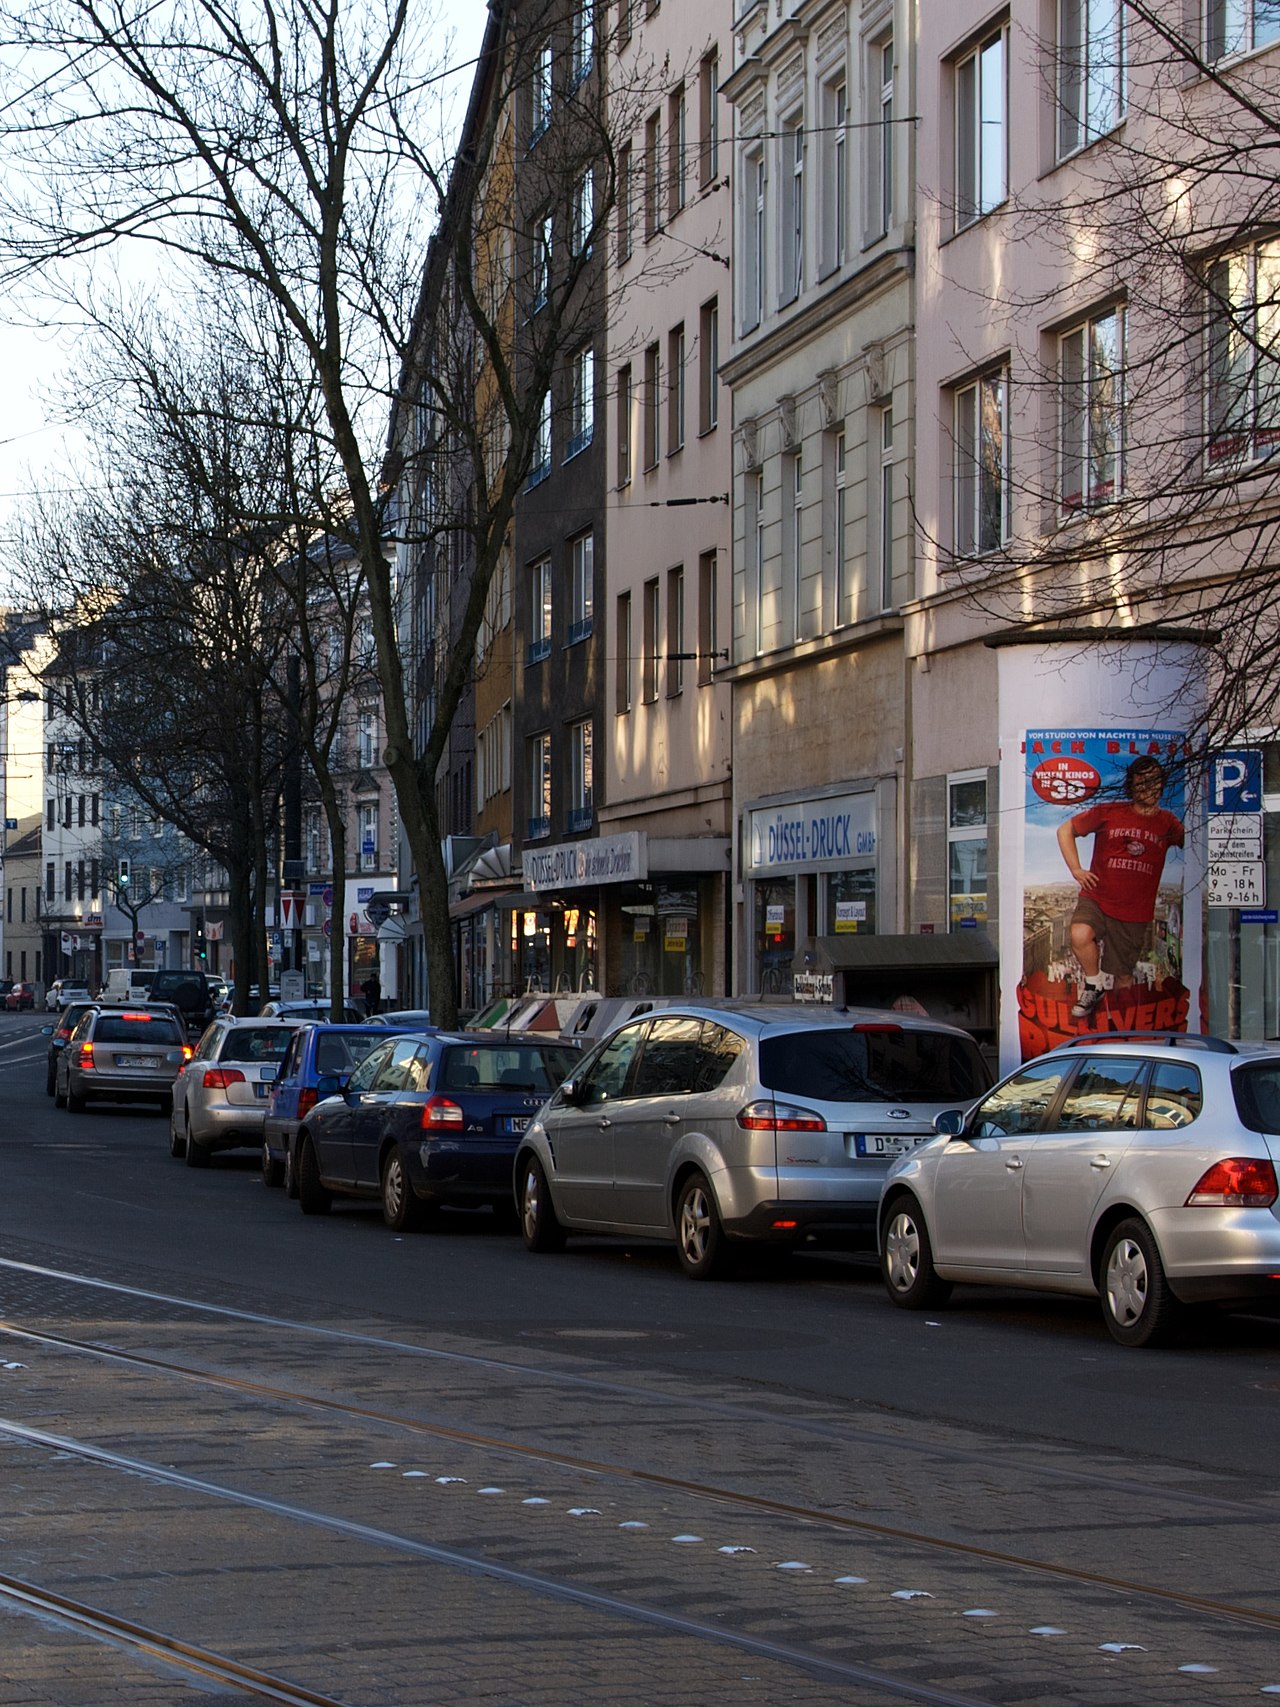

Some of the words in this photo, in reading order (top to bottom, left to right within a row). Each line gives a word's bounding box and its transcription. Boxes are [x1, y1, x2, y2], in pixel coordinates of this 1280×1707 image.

[1098, 732, 1136, 740] NACHTS
[1020, 741, 1086, 754] JACK
[1035, 771, 1063, 779] VIELEN
[1065, 771, 1095, 779] KINOS
[1215, 759, 1246, 806] P
[1050, 780, 1086, 800] 3D
[1211, 826, 1253, 834] Parkschein
[769, 814, 851, 863] DÜSSEL-DRUCK
[1231, 841, 1246, 849] dem
[1210, 866, 1227, 876] Mo
[1242, 866, 1255, 876] Fr
[1212, 880, 1218, 889] 9
[1234, 879, 1245, 889] 18
[1248, 879, 1255, 889] h
[1208, 892, 1222, 902] Sa
[1227, 892, 1250, 902] 9-16
[1253, 891, 1259, 902] h
[157, 941, 163, 950] P
